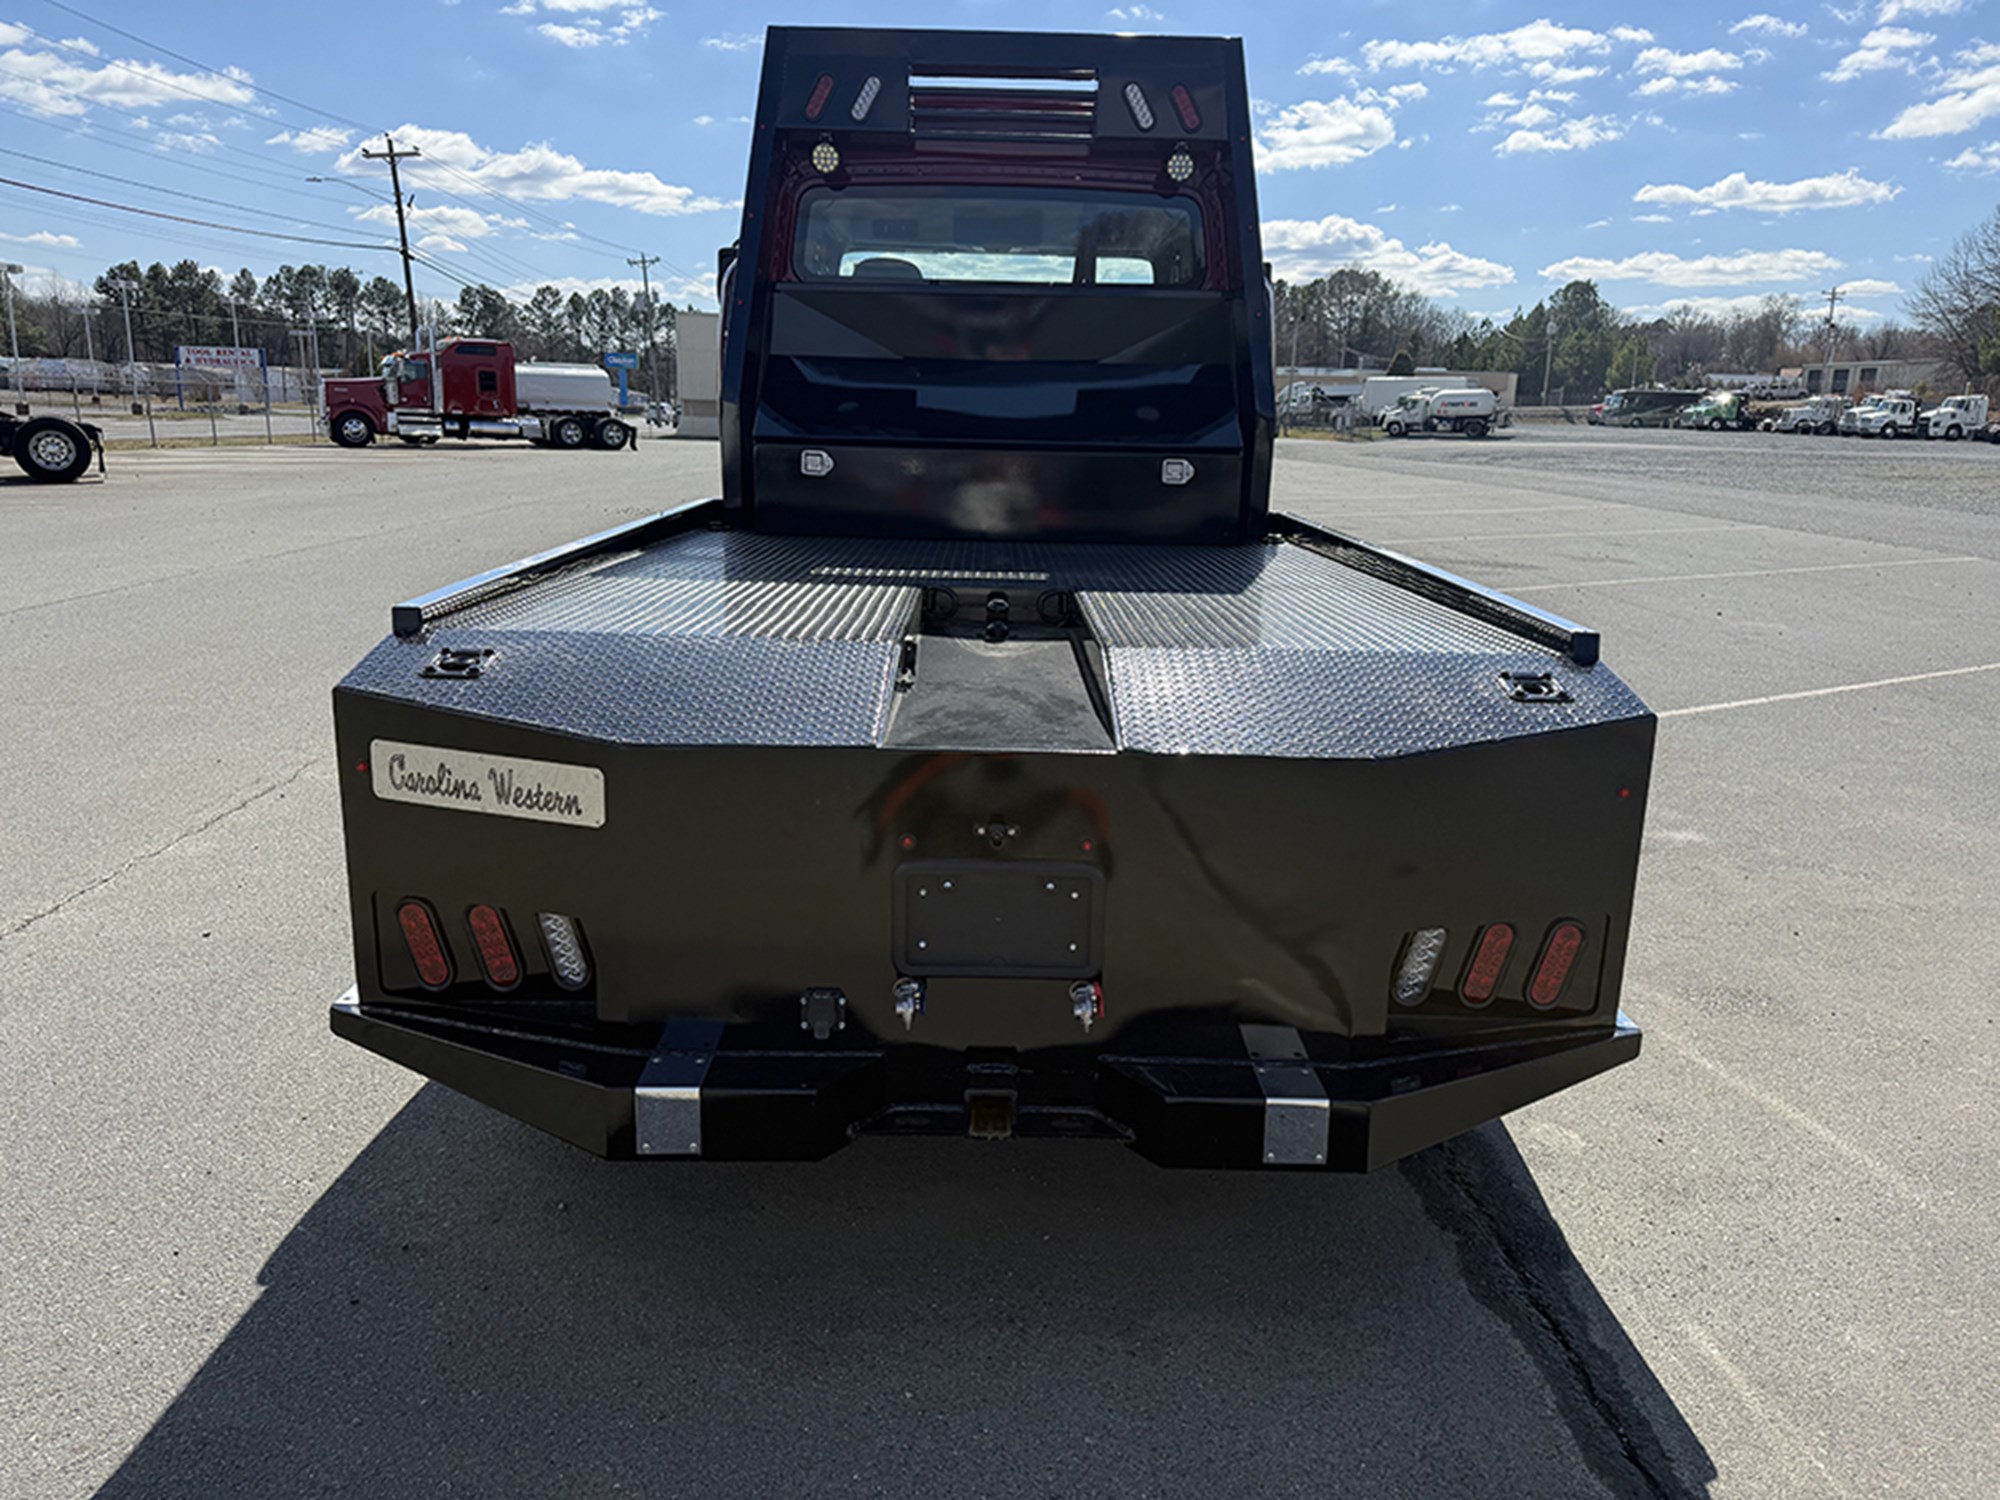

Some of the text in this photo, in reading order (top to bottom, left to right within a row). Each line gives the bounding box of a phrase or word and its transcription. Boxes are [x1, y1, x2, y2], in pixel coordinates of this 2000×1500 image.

[186, 348, 211, 356] TOOL
[195, 357, 256, 365] HYDRAULCS
[389, 753, 582, 816] Carolina Western
